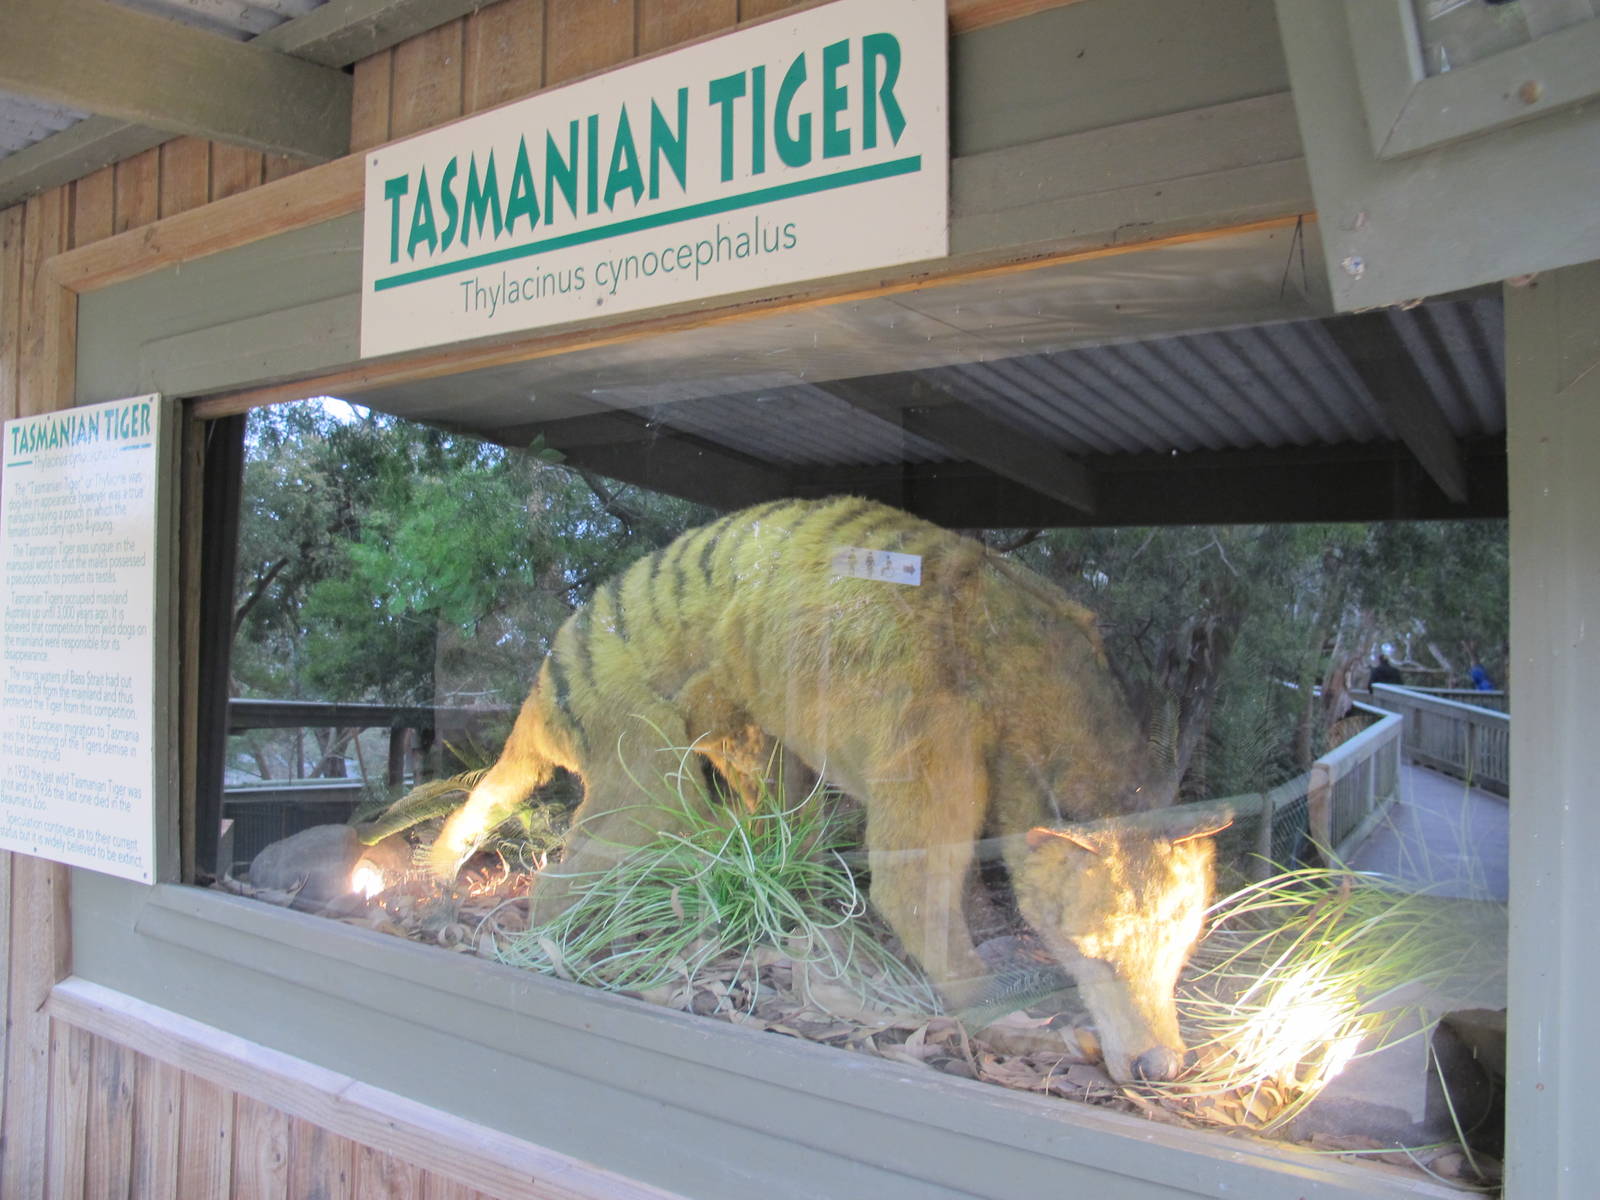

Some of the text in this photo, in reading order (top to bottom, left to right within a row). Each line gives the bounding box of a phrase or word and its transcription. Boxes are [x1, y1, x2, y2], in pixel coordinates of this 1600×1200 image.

[384, 32, 907, 264] TASMANIAN TIGER
[460, 216, 798, 319] Thylacinus cynocephalus
[12, 403, 152, 456] TASMANIAN TIGER
